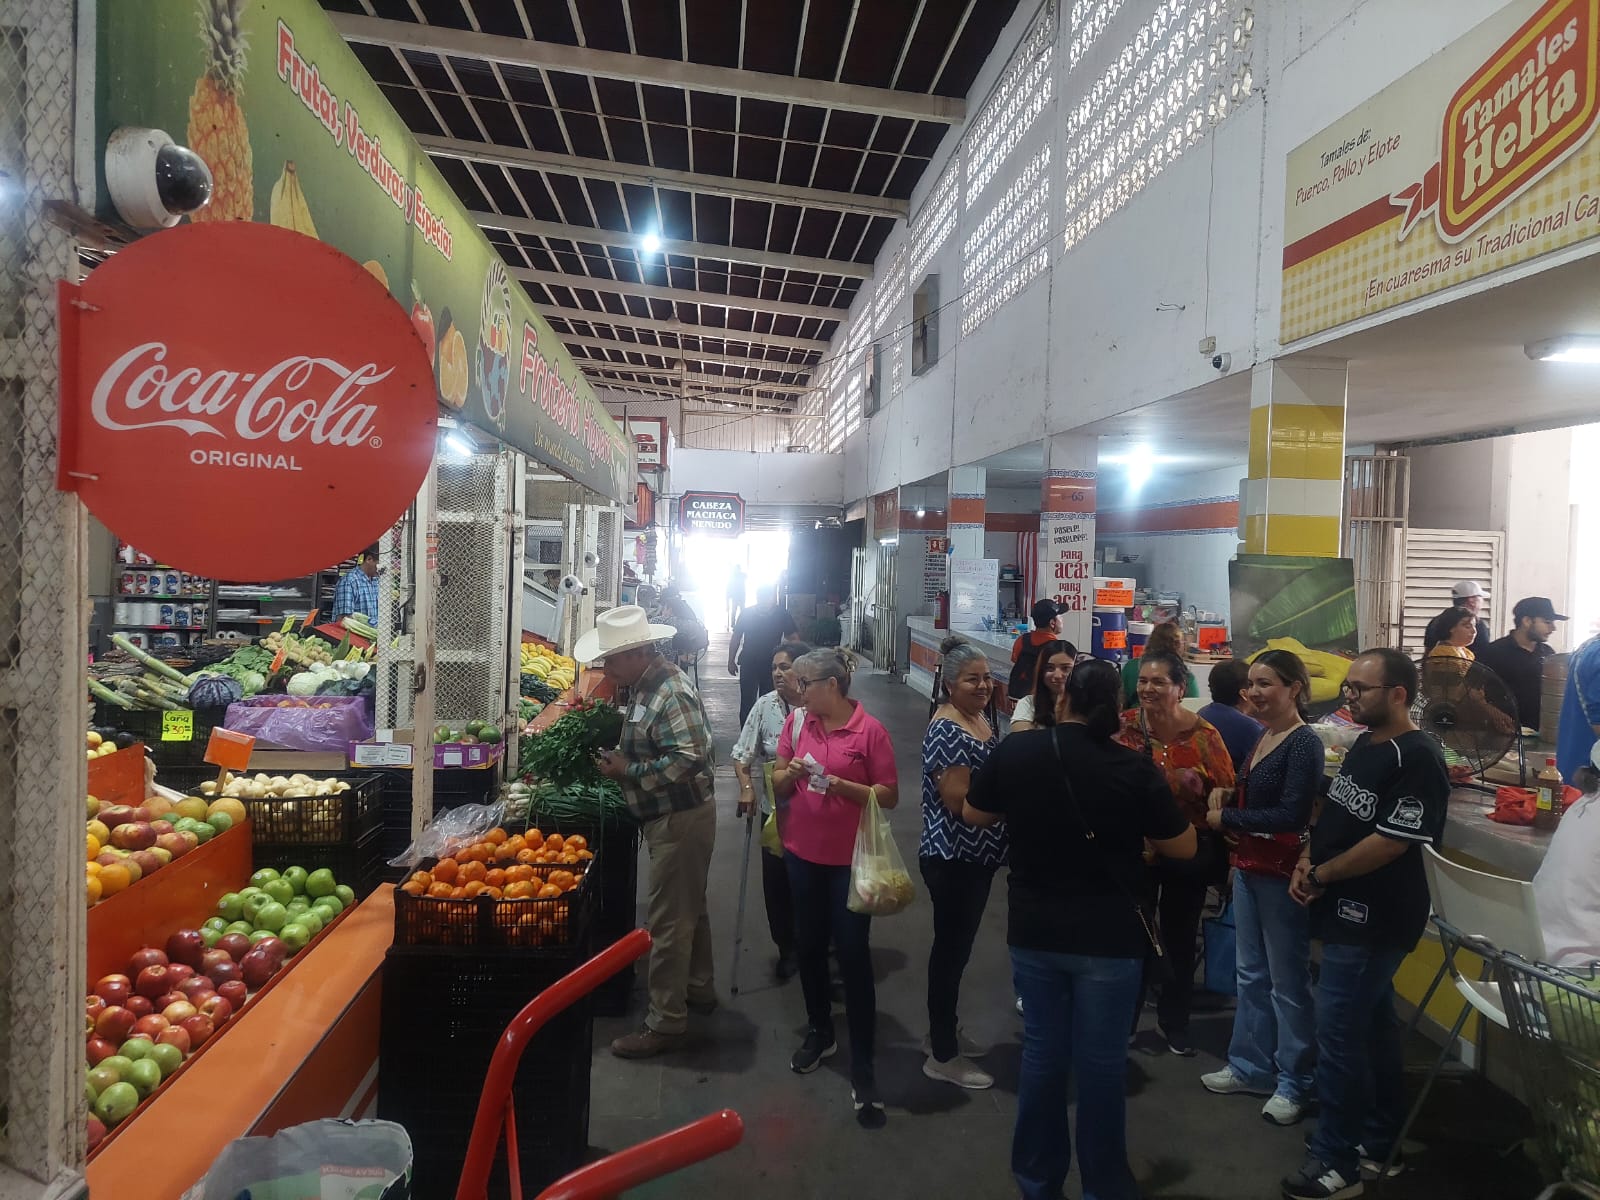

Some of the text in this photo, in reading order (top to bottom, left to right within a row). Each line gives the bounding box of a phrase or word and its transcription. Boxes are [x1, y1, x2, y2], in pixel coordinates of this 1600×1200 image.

[1462, 17, 1577, 143] Tamales
[278, 18, 452, 262] Frutas, Verduras y Especias
[1295, 134, 1401, 207] Puerco, Pollo y Elote
[1320, 128, 1372, 169] Tamales de:
[1461, 69, 1577, 201] Helia
[1385, 255, 1451, 294] cuaresma
[1454, 247, 1472, 267] su
[1477, 201, 1571, 259] Tradicional
[1574, 194, 1600, 227] Ca
[91, 342, 396, 446] Coca-Cola
[519, 321, 580, 440] Frutería
[190, 449, 303, 471] ORIGINAL
[687, 510, 736, 520] MACHACA
[691, 521, 732, 529] MENUDO
[692, 501, 732, 511] CABEZA
[1054, 560, 1089, 579] acá!
